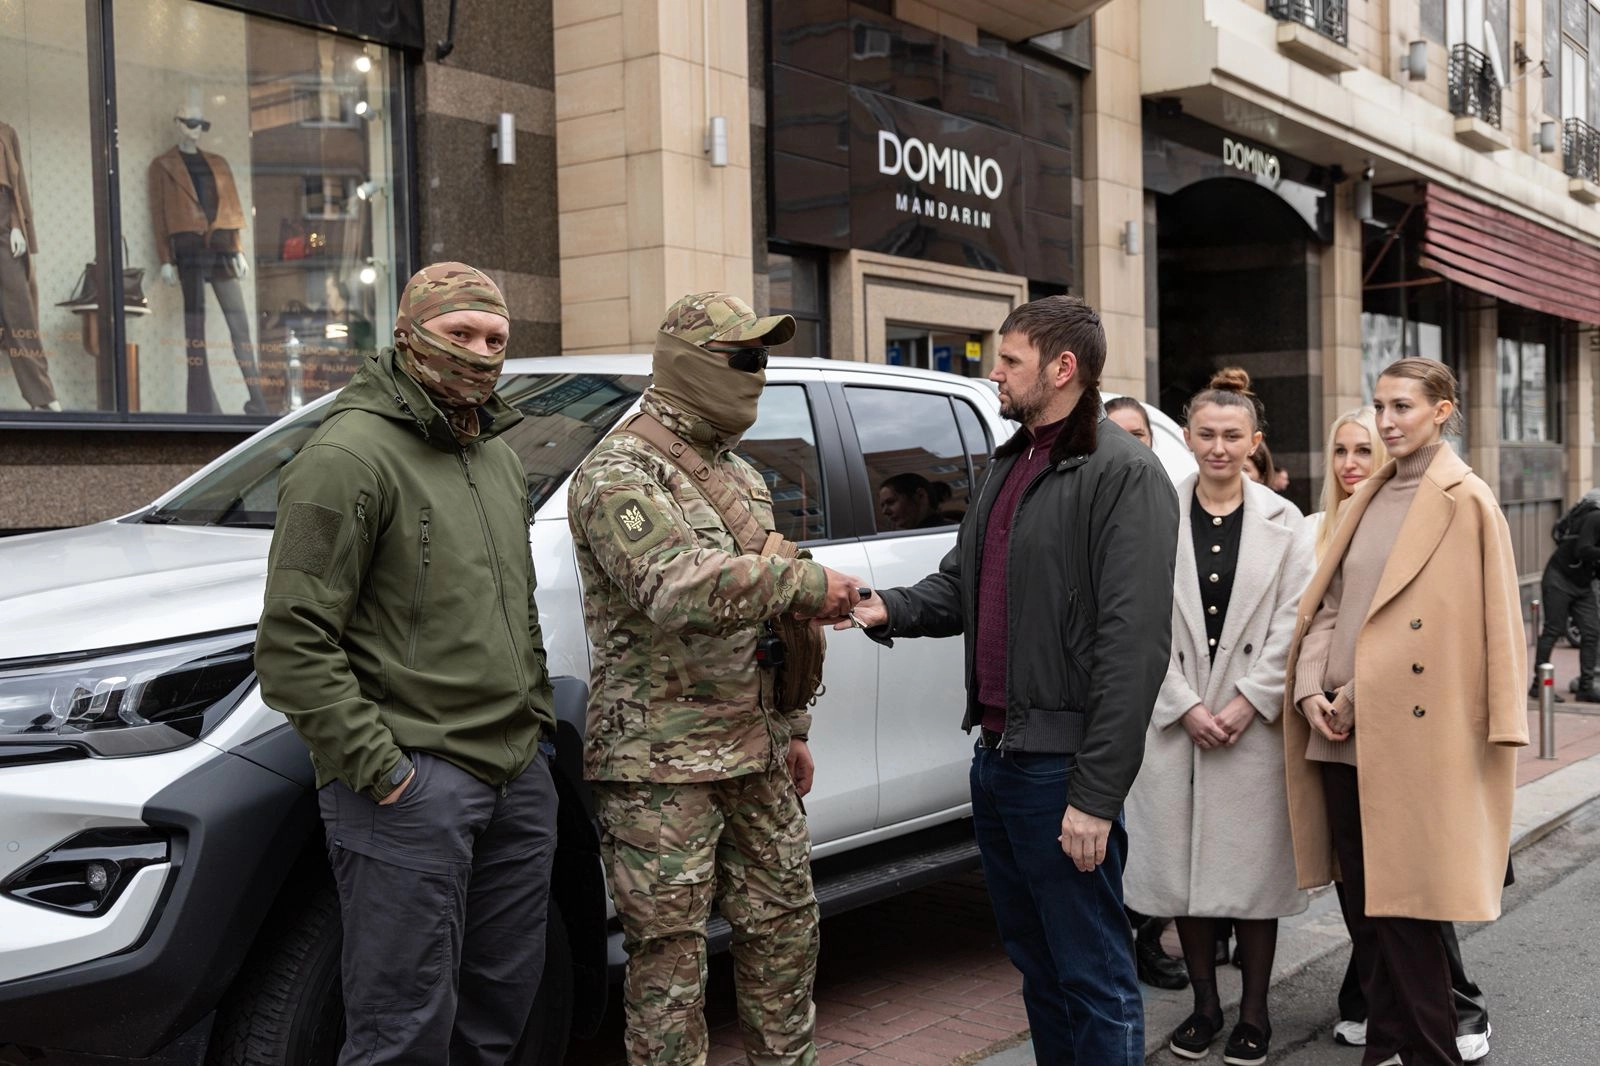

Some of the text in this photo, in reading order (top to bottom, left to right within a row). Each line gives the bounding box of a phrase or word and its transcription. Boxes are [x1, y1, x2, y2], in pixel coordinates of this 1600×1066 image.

[878, 129, 1003, 200] DOMINO
[1223, 137, 1280, 182] DOMINO
[896, 193, 991, 229] MANDARIN
